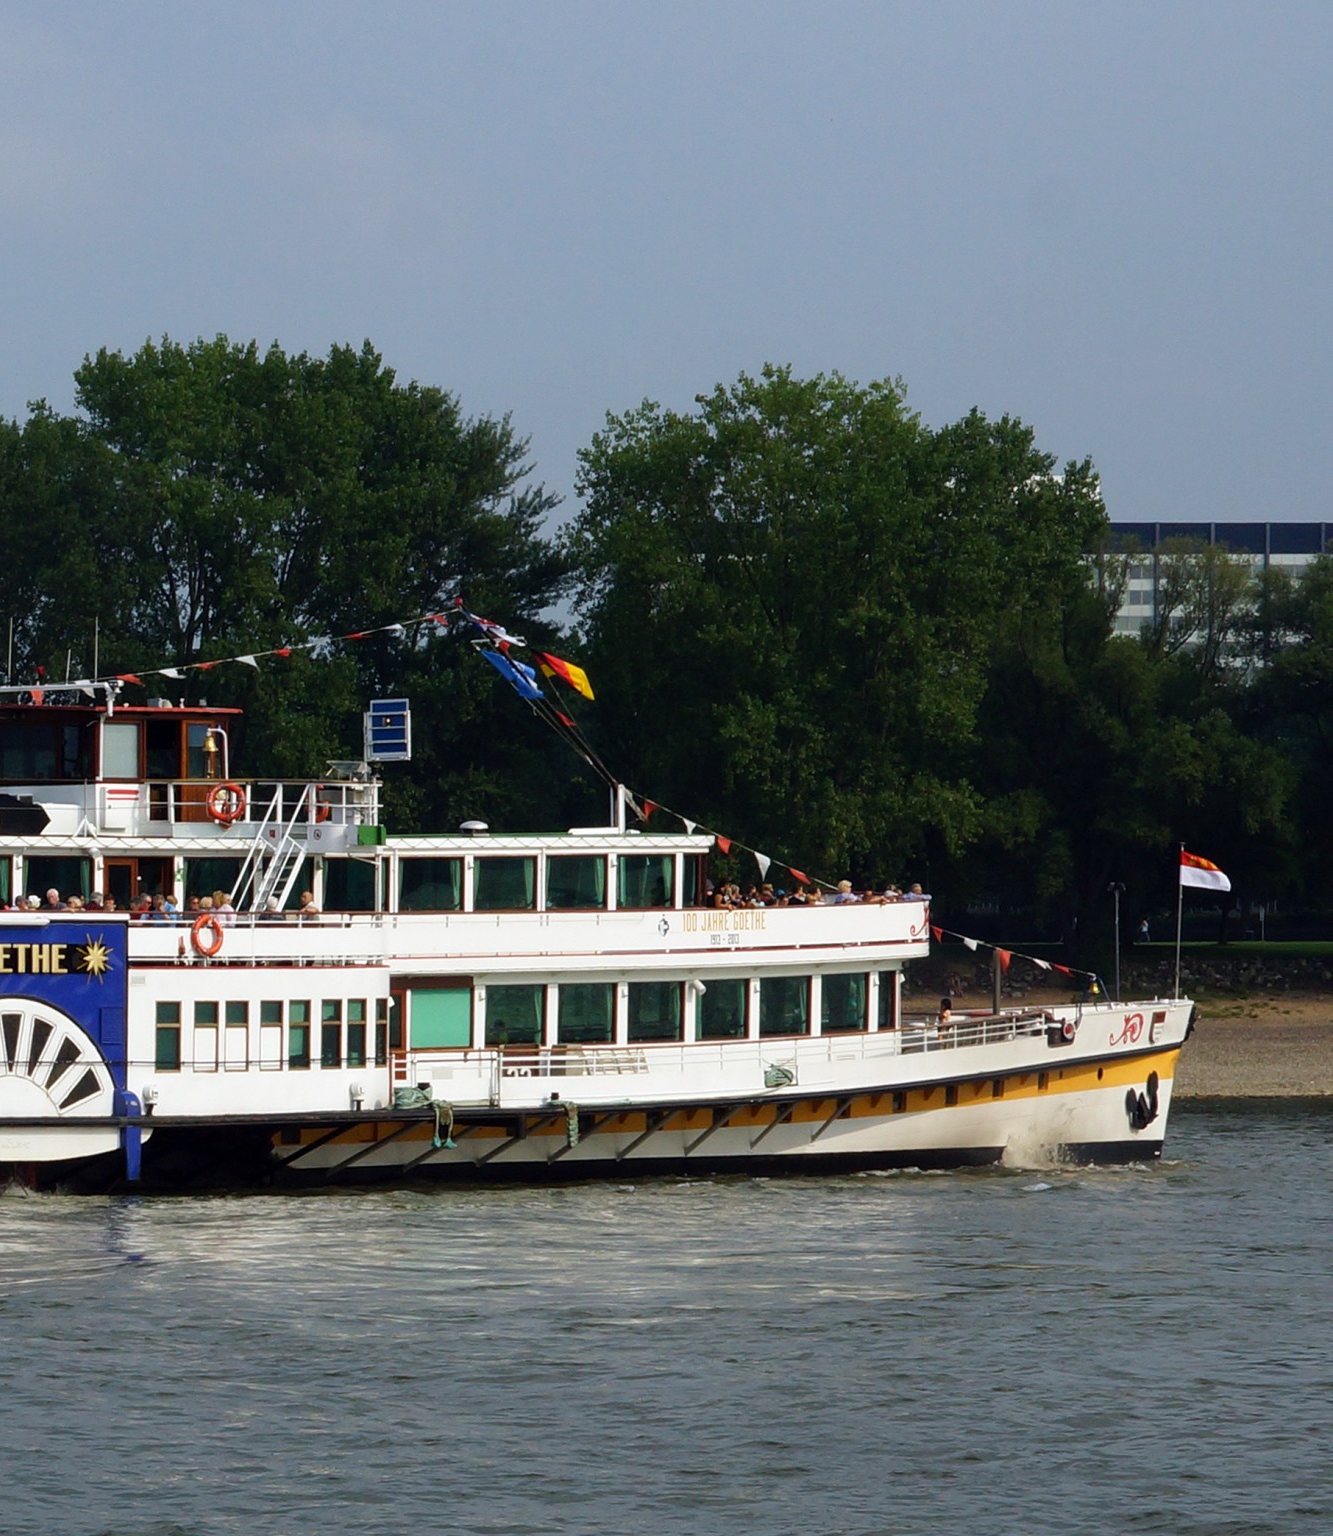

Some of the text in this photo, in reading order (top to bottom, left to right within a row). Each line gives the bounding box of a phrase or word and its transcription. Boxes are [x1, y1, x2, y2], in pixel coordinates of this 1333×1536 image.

[683, 911, 766, 932] 100 JAHRE GOETHE
